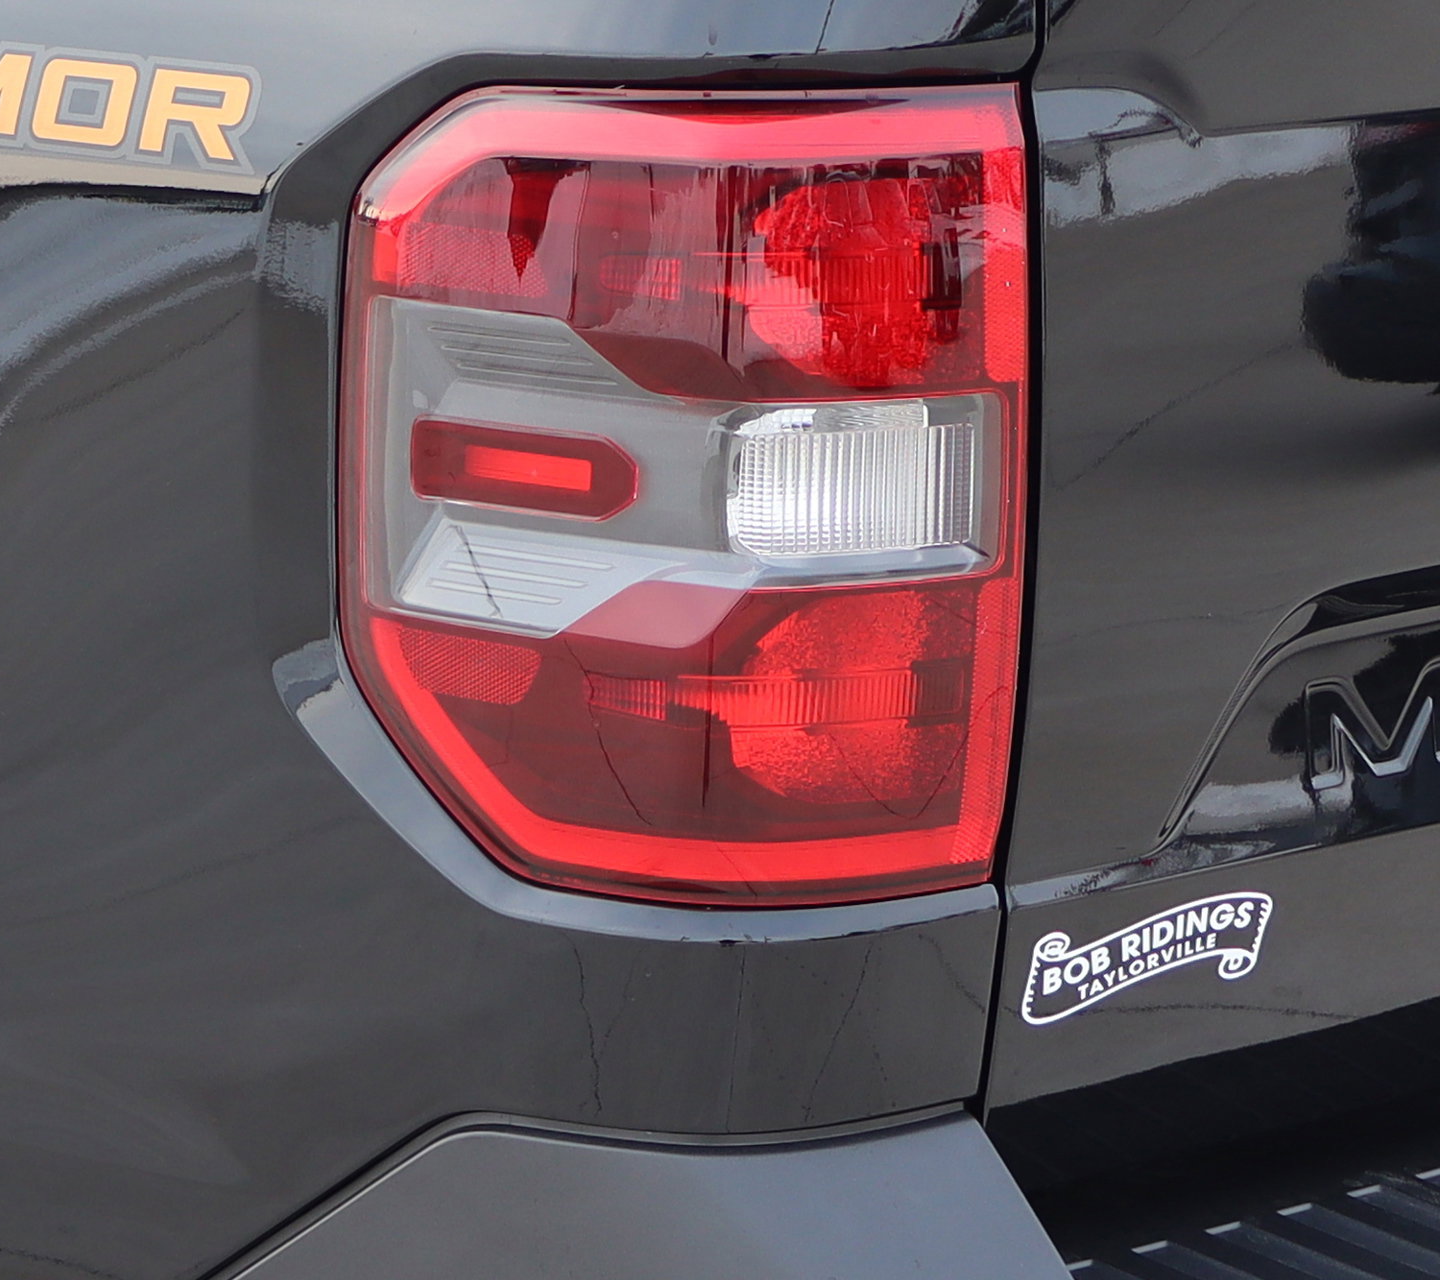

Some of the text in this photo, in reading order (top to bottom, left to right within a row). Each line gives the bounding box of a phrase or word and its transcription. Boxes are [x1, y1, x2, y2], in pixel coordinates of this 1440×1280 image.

[1042, 900, 1255, 996] BOB RIDINGS
[1077, 933, 1217, 1000] TAYLORVILLE
